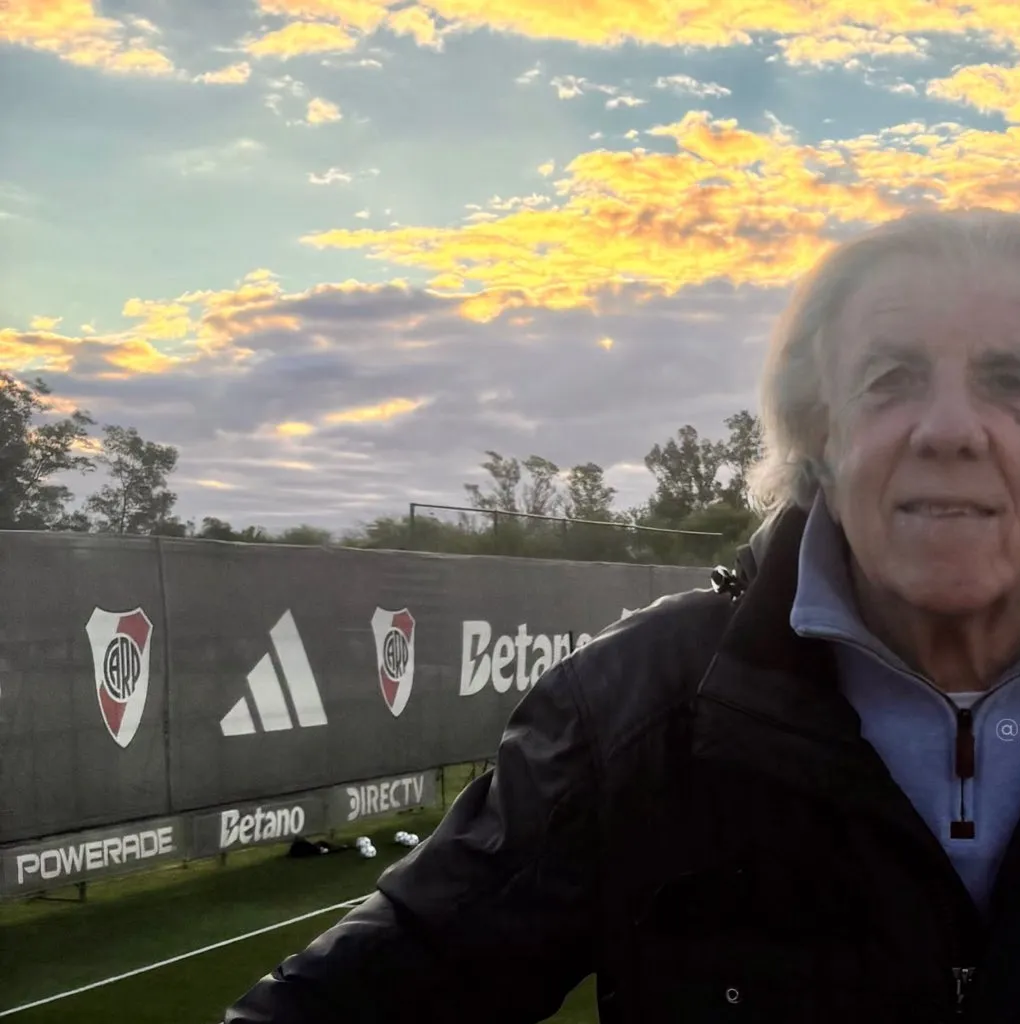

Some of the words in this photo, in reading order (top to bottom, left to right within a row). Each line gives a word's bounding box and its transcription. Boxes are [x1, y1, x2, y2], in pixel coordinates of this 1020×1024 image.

[104, 636, 141, 699] CARP
[459, 620, 593, 696] Betan
[220, 806, 305, 848] Betano
[346, 776, 425, 821] DIRECTV
[16, 826, 174, 884] POWERADE
